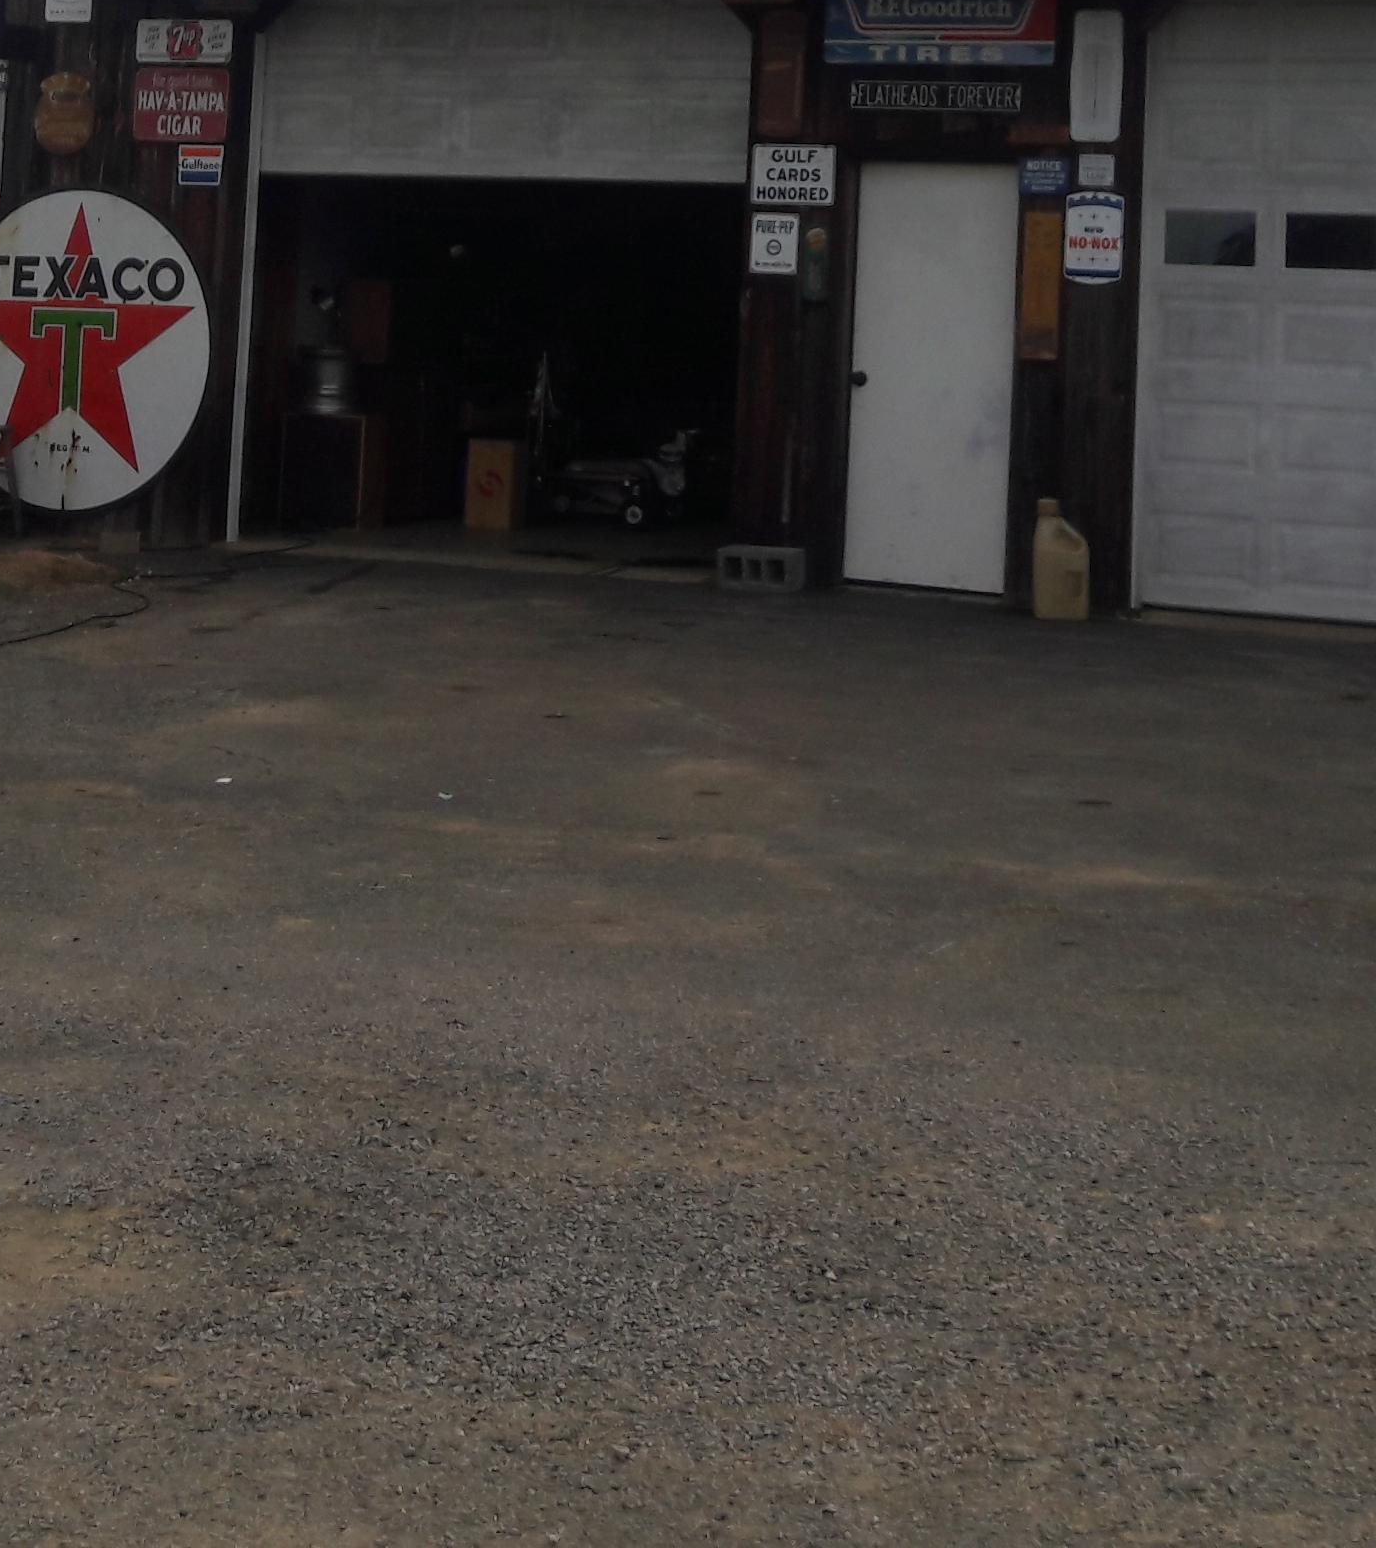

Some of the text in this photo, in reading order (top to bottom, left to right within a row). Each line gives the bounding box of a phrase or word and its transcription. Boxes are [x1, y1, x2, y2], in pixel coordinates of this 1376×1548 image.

[868, 45, 1004, 62] TIRES
[857, 83, 1015, 109] FLATHEADS FOREVER
[157, 114, 202, 136] CIGAR
[772, 149, 818, 163] GULF
[1026, 160, 1062, 171] NOTICE
[766, 168, 821, 182] CARDS
[756, 186, 829, 201] HONORED
[30, 308, 118, 414] T
